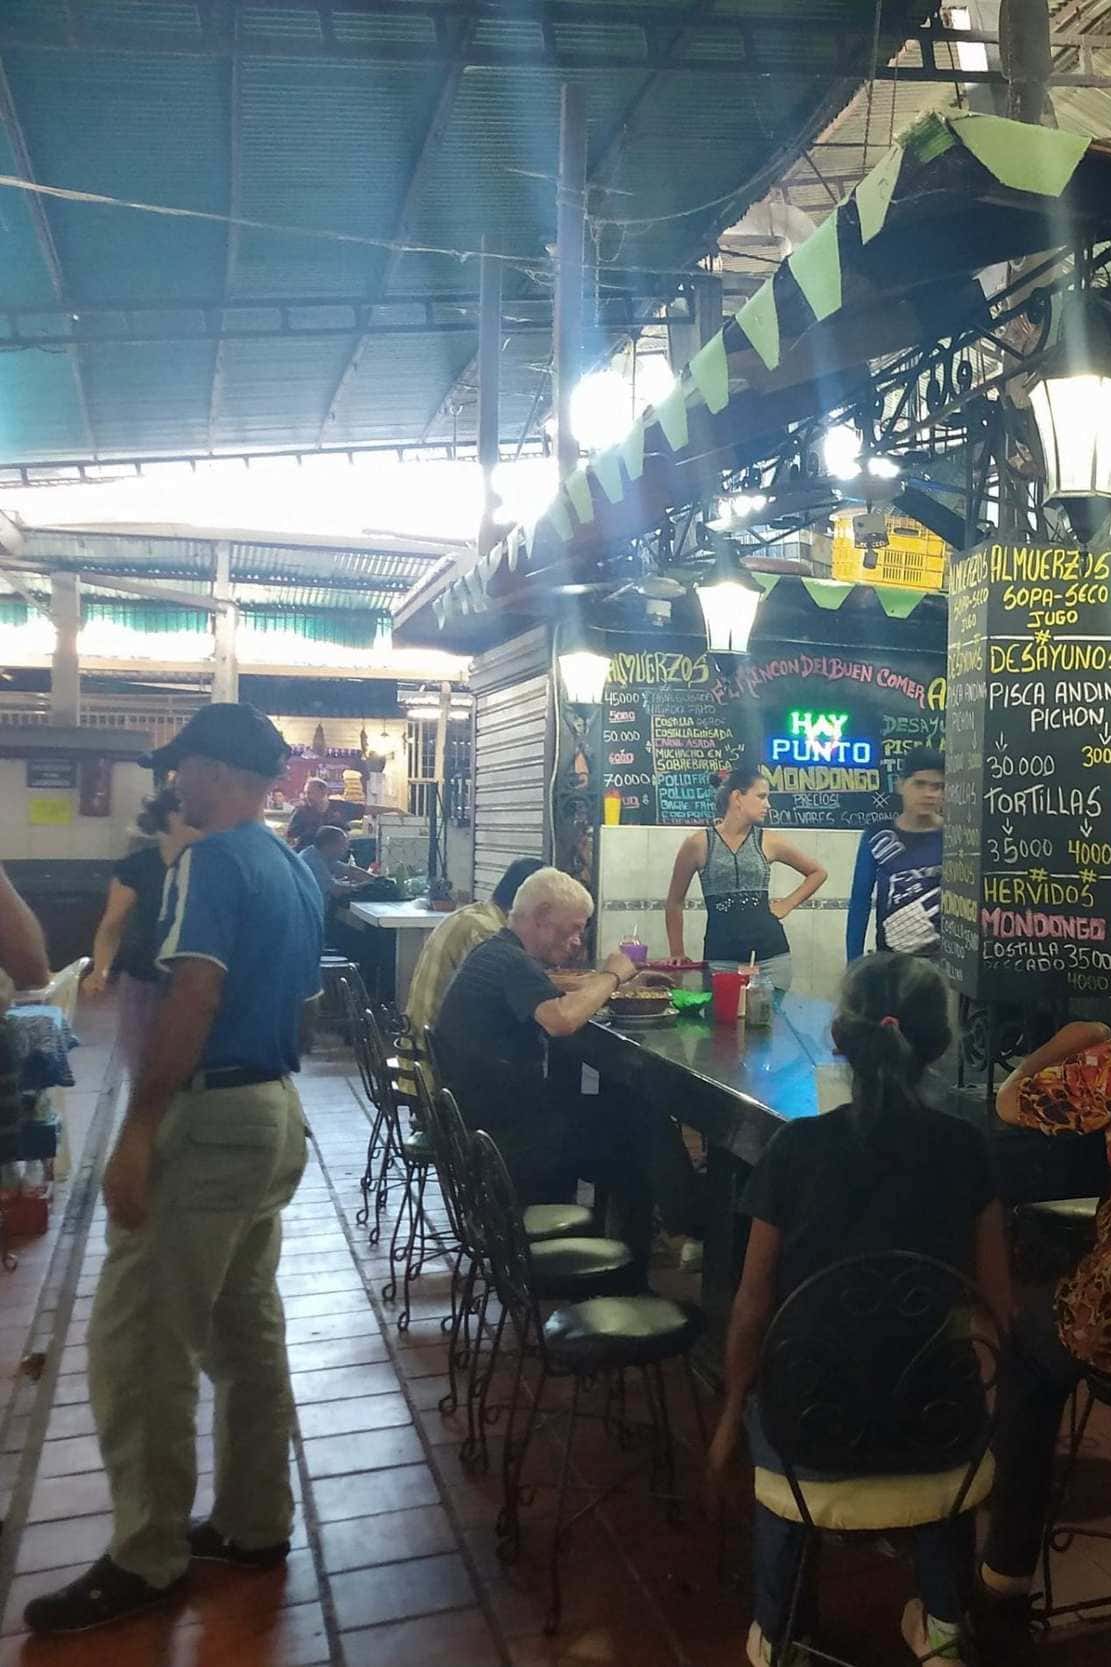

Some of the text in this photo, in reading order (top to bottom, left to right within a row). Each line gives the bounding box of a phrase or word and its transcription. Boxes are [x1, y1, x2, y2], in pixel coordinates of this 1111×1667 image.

[1027, 610, 1078, 628] JUGO
[876, 668, 927, 709] COMER
[989, 682, 1046, 710] PISCA
[791, 711, 849, 737] HAY
[1030, 706, 1104, 732] PICHON
[772, 739, 871, 764] PUNTO
[759, 765, 880, 793] MONDONGO
[659, 786, 695, 800] POLLO
[983, 784, 1102, 818] TORTILLAS
[987, 838, 1053, 864] 35000
[983, 877, 1095, 908] HERVIDOS
[980, 907, 1106, 940] MONDONGO
[983, 941, 1060, 960] COSTILLA
